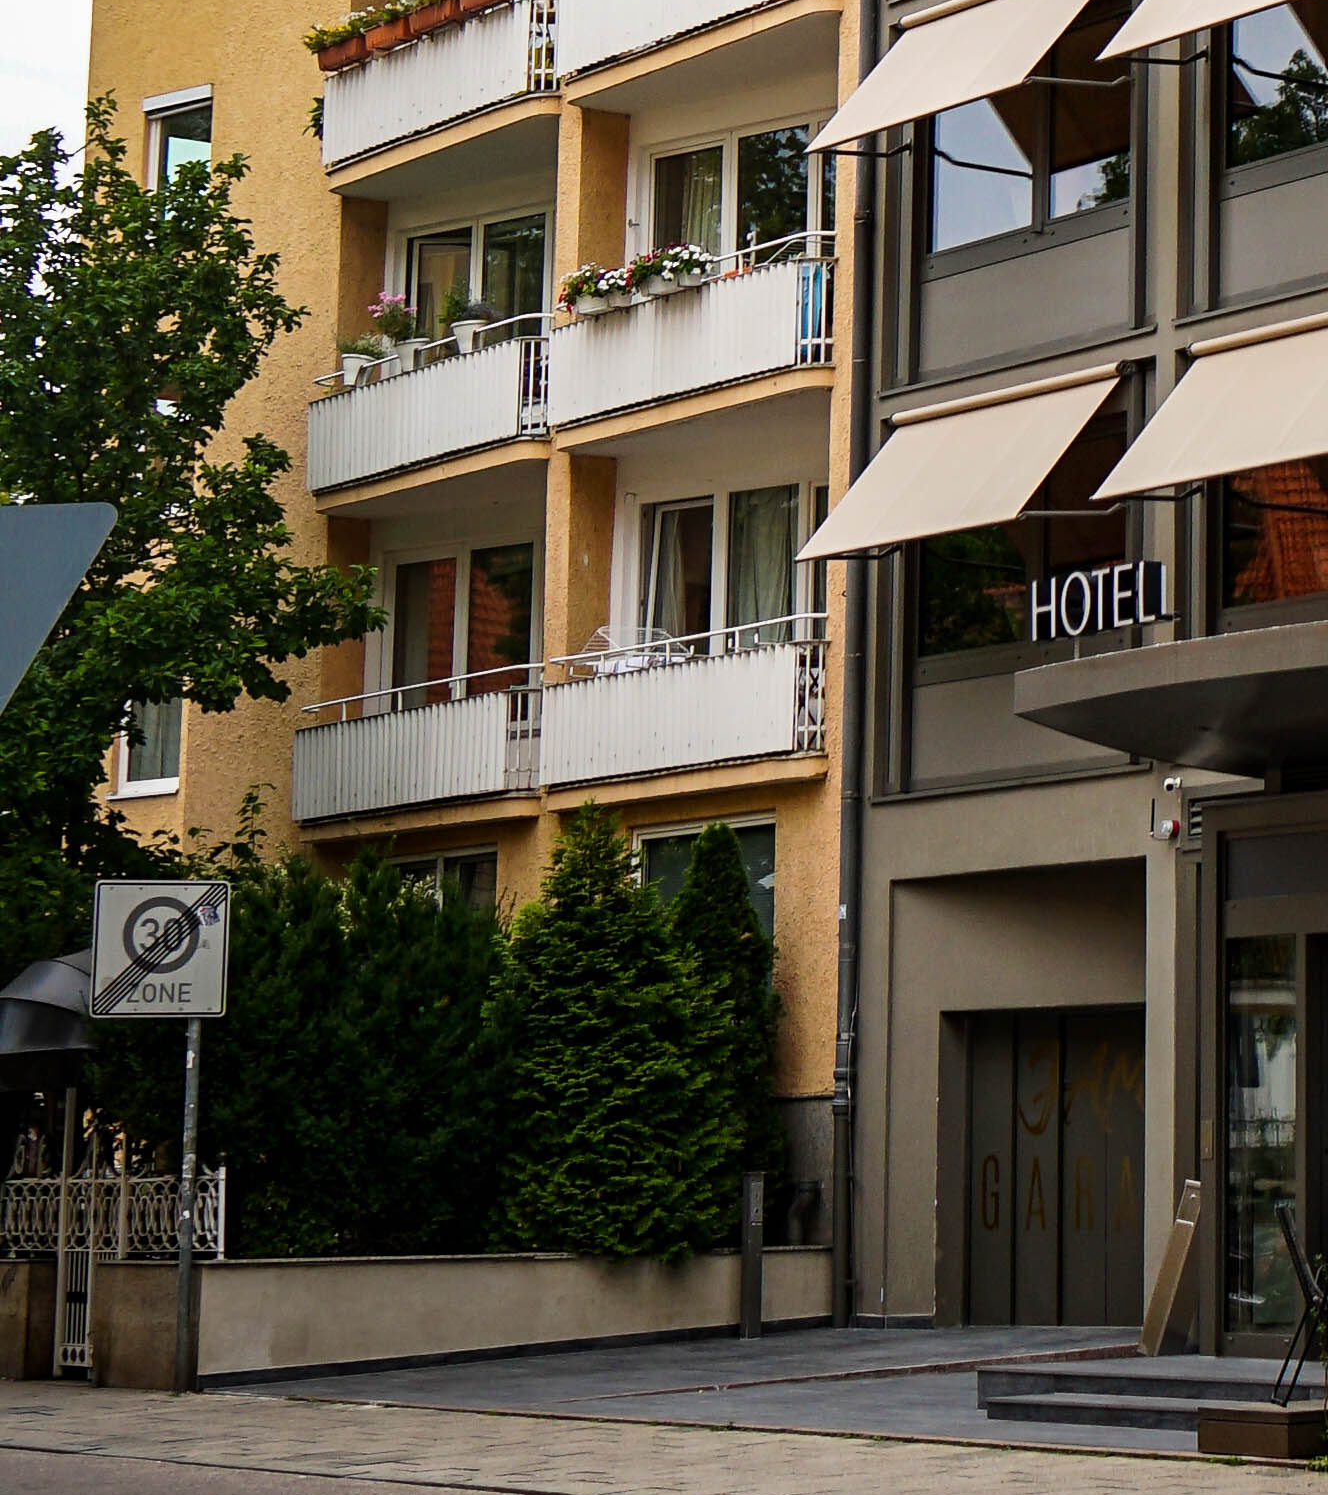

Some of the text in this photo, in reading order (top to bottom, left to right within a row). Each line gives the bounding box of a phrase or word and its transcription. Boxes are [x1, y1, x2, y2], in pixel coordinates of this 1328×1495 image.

[1031, 560, 1156, 642] HOTEL
[139, 917, 184, 952] 30
[126, 982, 193, 1004] ZONE
